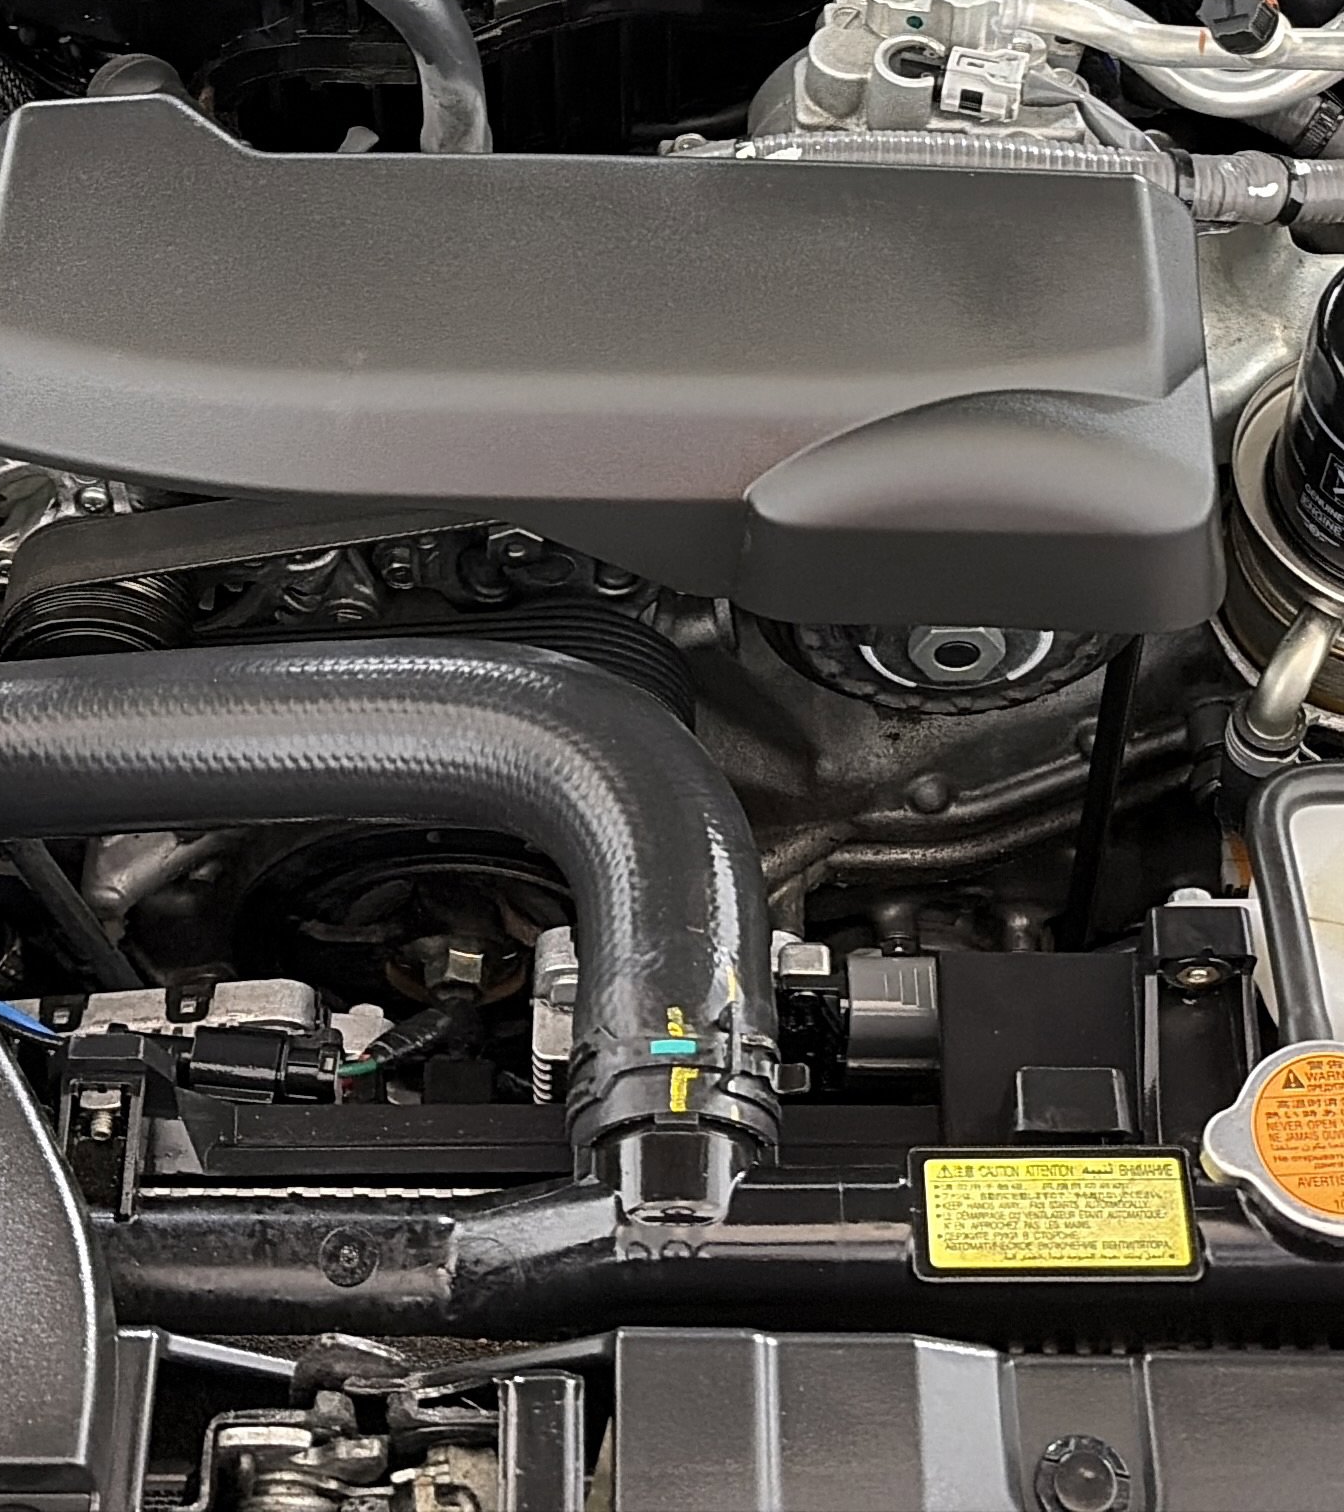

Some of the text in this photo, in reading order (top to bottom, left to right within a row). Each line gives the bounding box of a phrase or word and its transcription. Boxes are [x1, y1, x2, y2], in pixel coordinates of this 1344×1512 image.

[1267, 1120, 1302, 1131] NEVER
[1307, 1118, 1337, 1130] OPEN
[1268, 1133, 1283, 1143] NE
[1285, 1131, 1319, 1142] JAMAIS
[978, 1165, 1019, 1177] CAUTION
[1025, 1164, 1074, 1177] ATTENTION
